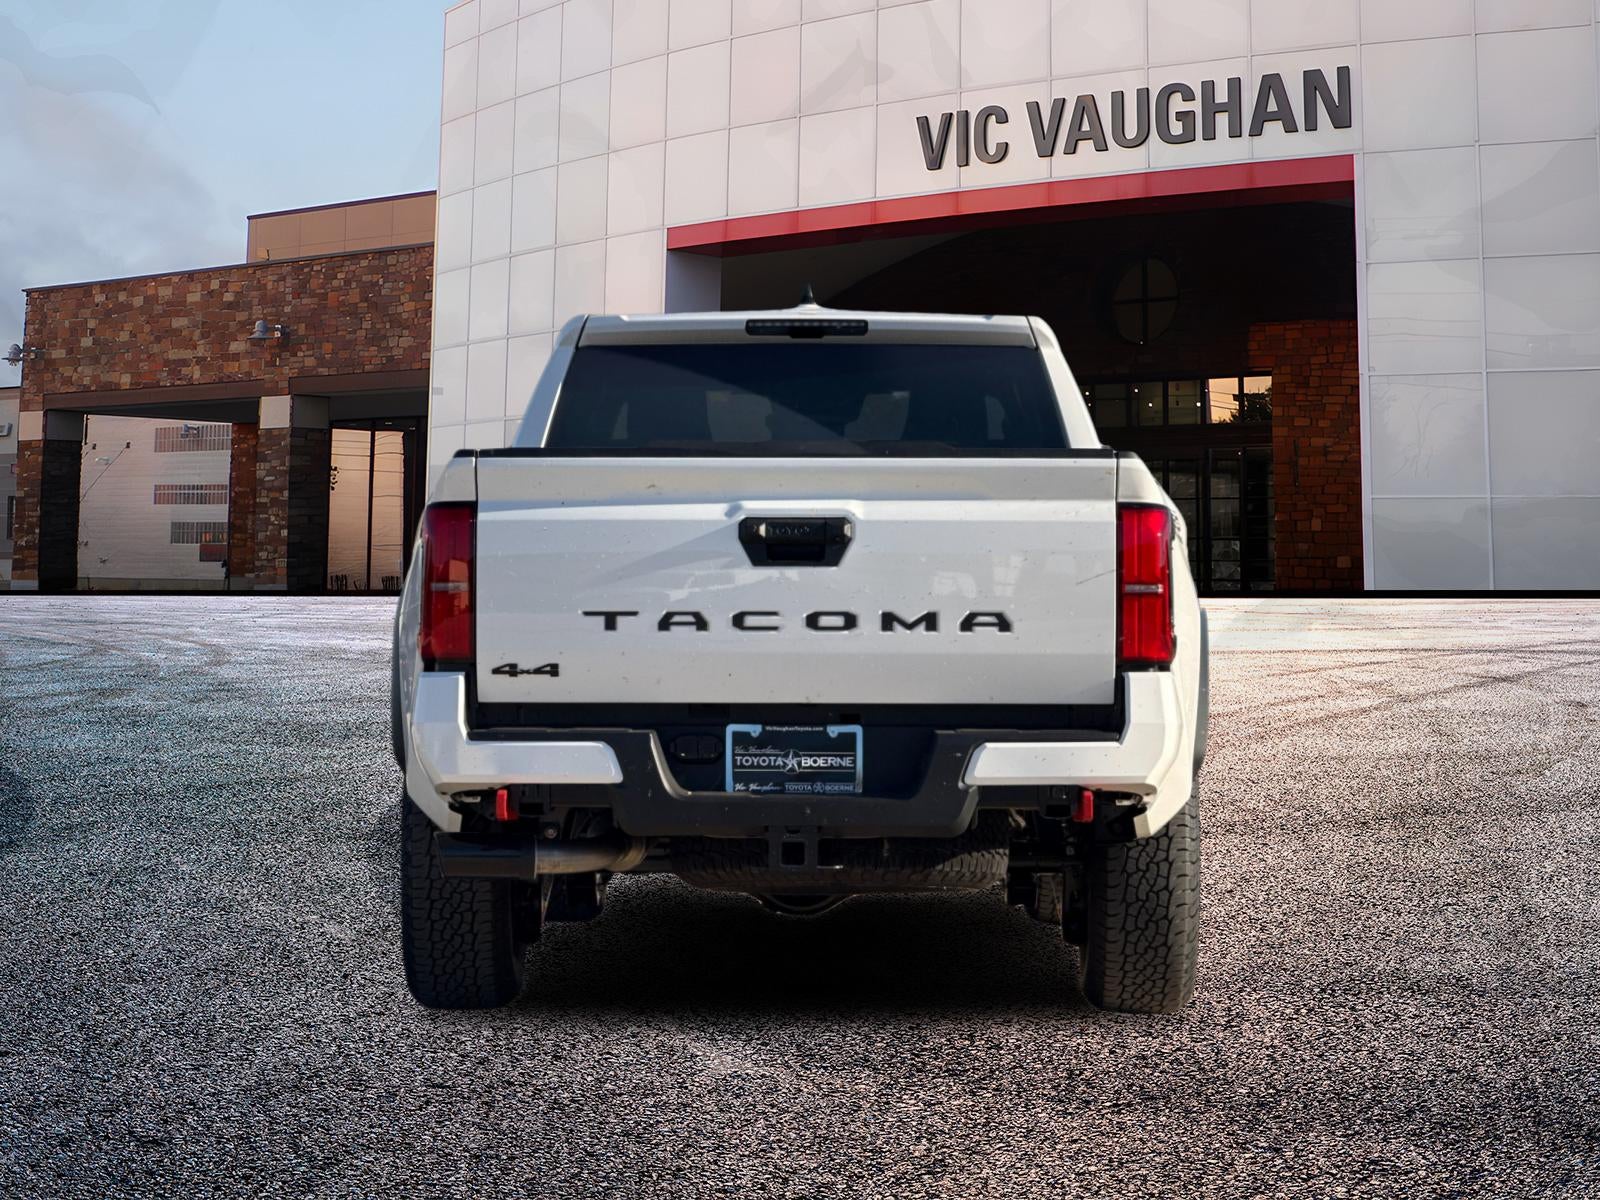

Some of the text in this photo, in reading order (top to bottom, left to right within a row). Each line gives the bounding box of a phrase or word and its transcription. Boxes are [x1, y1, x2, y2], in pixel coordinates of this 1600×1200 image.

[916, 65, 1352, 171] VIC VAUGHAN
[582, 611, 1013, 633] TACOMA
[735, 756, 855, 767] TOYOTA BOERNE
[785, 784, 812, 792] TOYOTA
